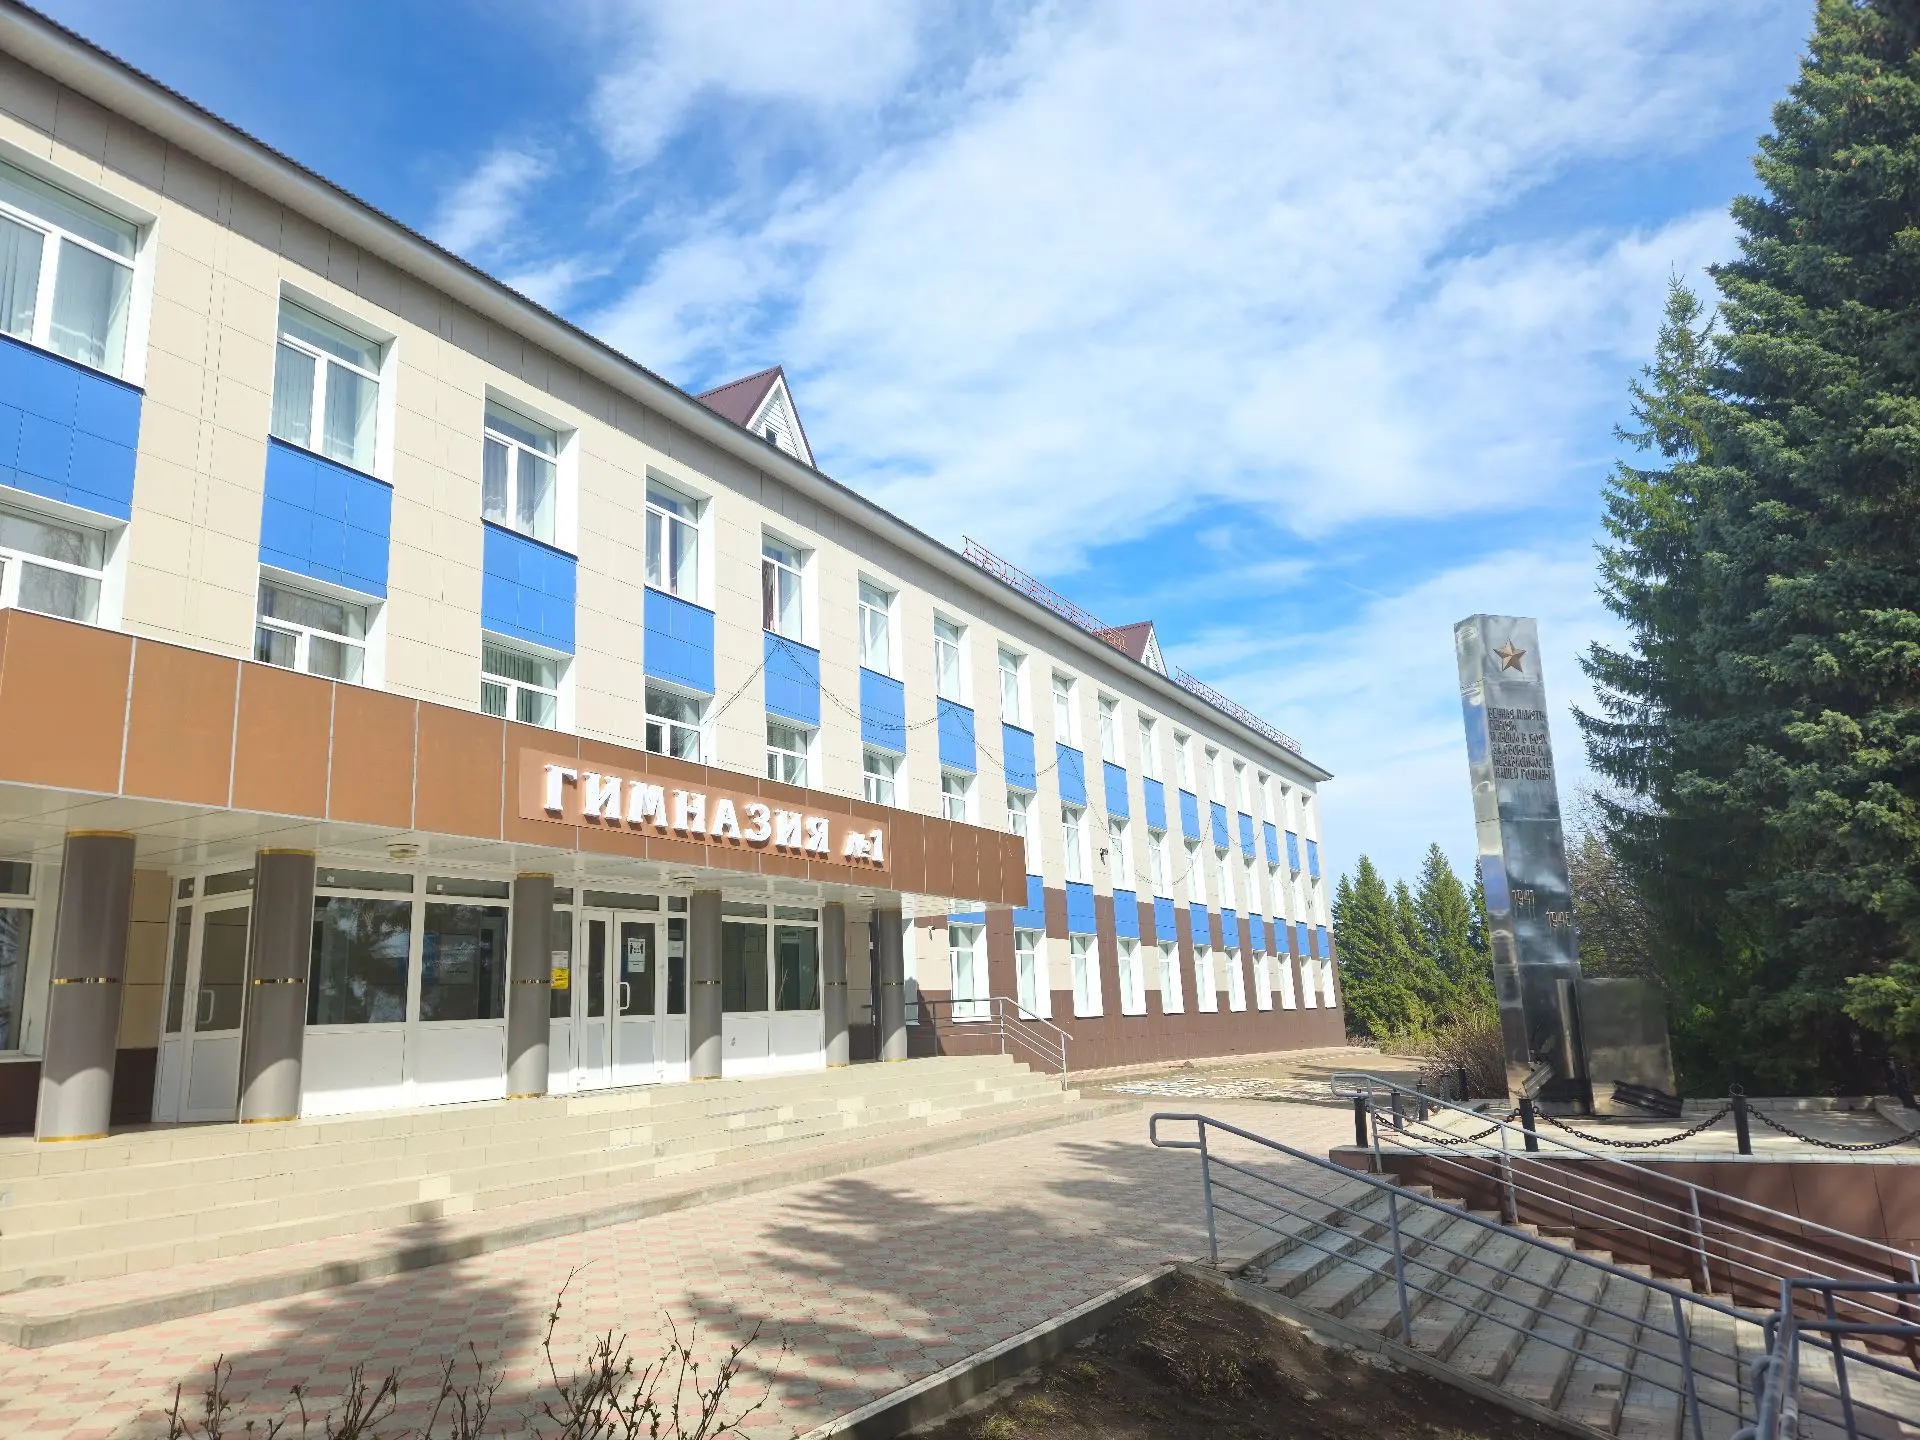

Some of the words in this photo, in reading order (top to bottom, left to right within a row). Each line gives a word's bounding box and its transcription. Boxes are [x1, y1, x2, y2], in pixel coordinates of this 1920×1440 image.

[1488, 707, 1514, 719] ВЕЧНАЯ
[543, 763, 831, 855] ГИМНАЗИЯ
[844, 829, 885, 863] №1
